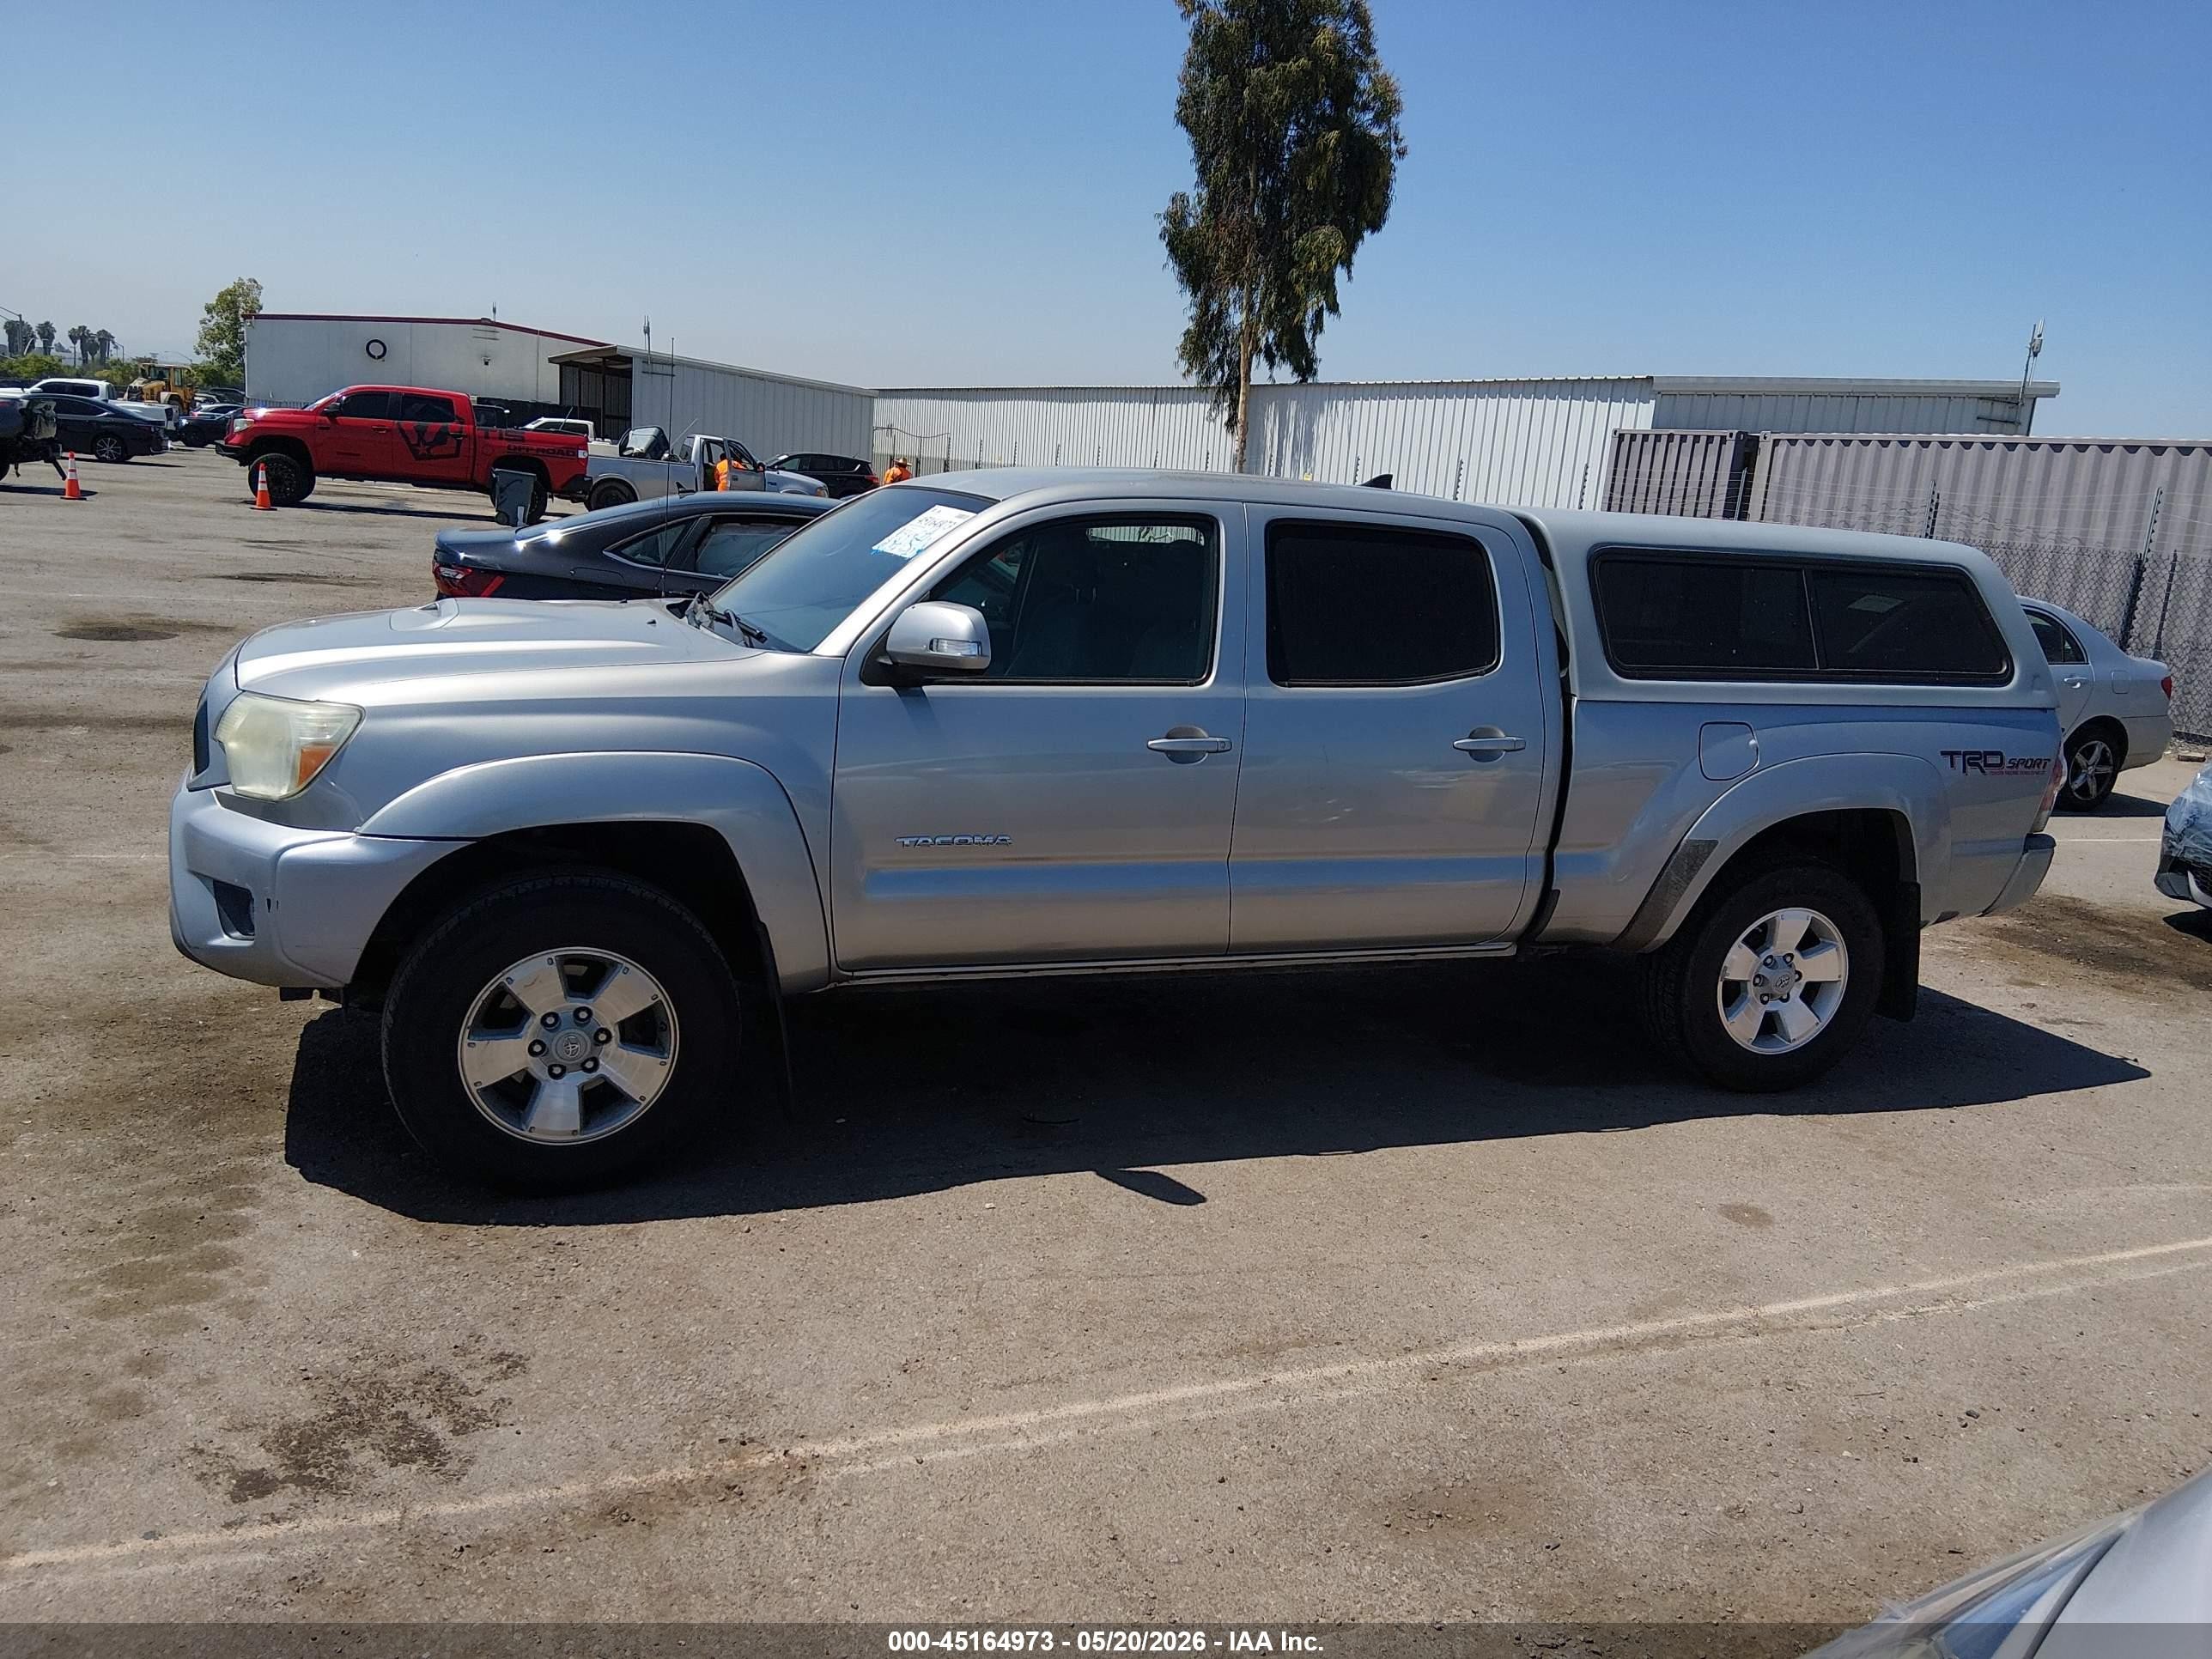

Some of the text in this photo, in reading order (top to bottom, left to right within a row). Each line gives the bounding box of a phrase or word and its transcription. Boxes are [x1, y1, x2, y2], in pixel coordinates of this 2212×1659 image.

[1939, 750, 2051, 775] TRD SPORT
[896, 834, 1012, 848] TACOMA
